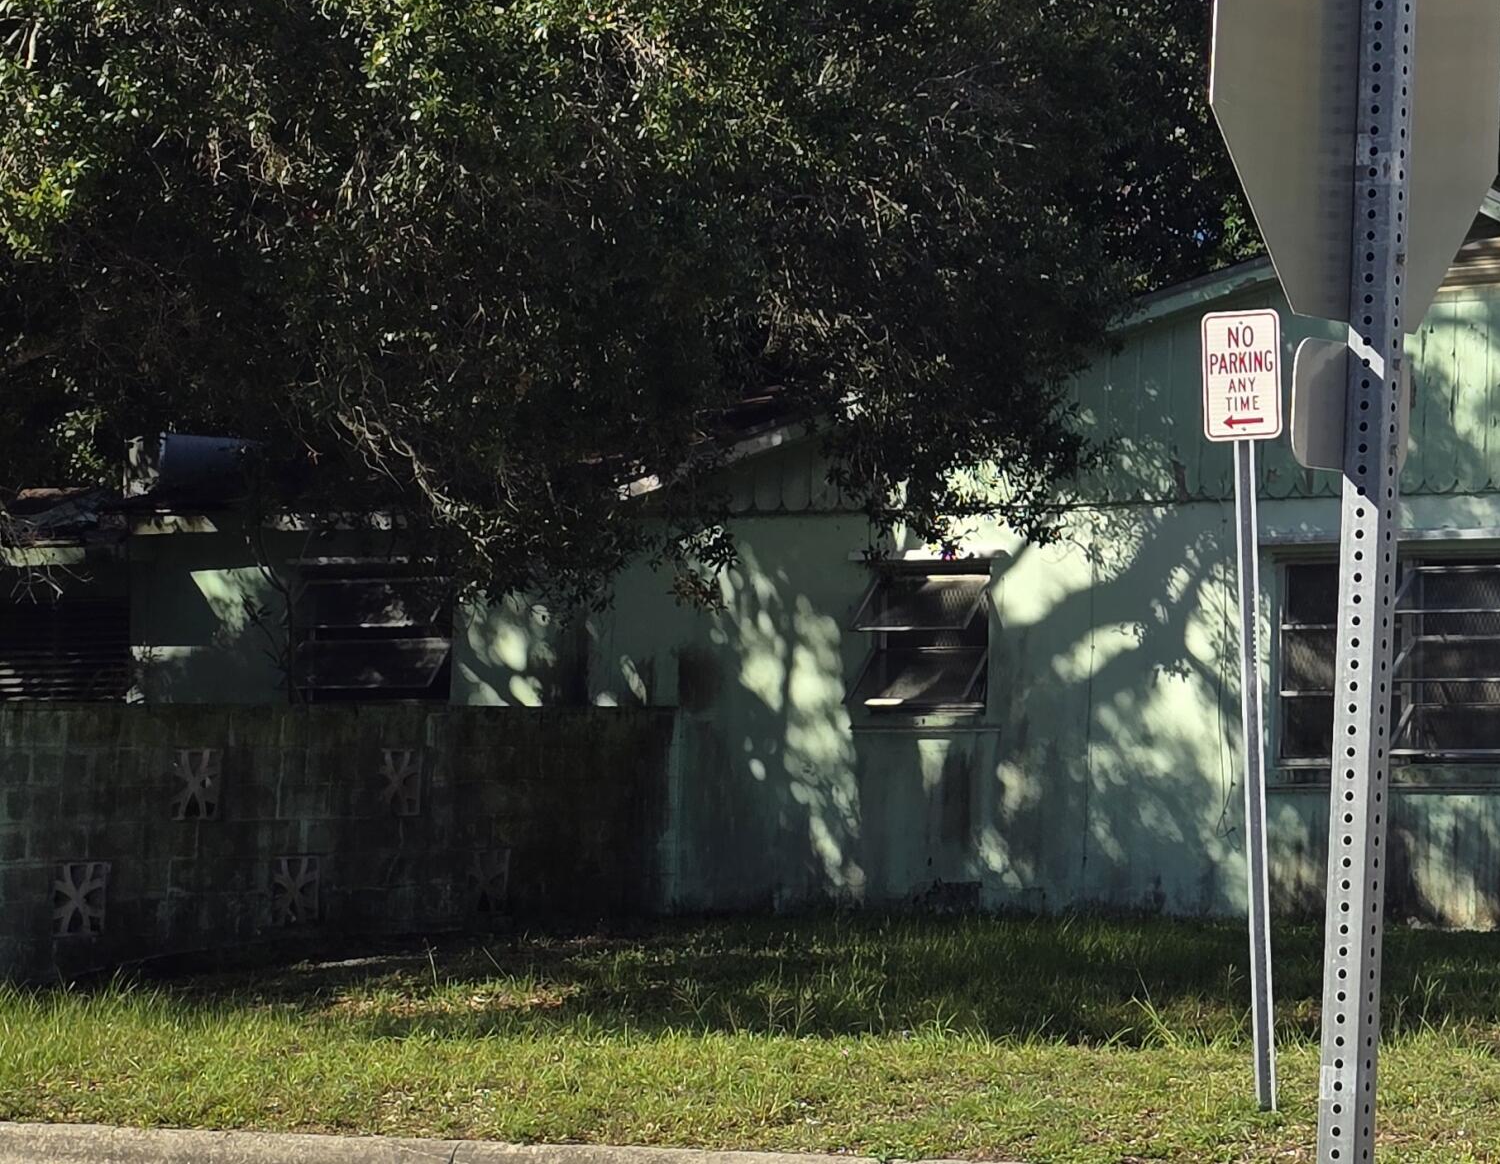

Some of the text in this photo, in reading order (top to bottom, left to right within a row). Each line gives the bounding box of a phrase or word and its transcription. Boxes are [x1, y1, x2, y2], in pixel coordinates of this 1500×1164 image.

[1227, 325, 1254, 348] NO
[1209, 350, 1274, 375] PARKING
[1228, 377, 1256, 393] ANY
[1225, 395, 1260, 412] TIME
